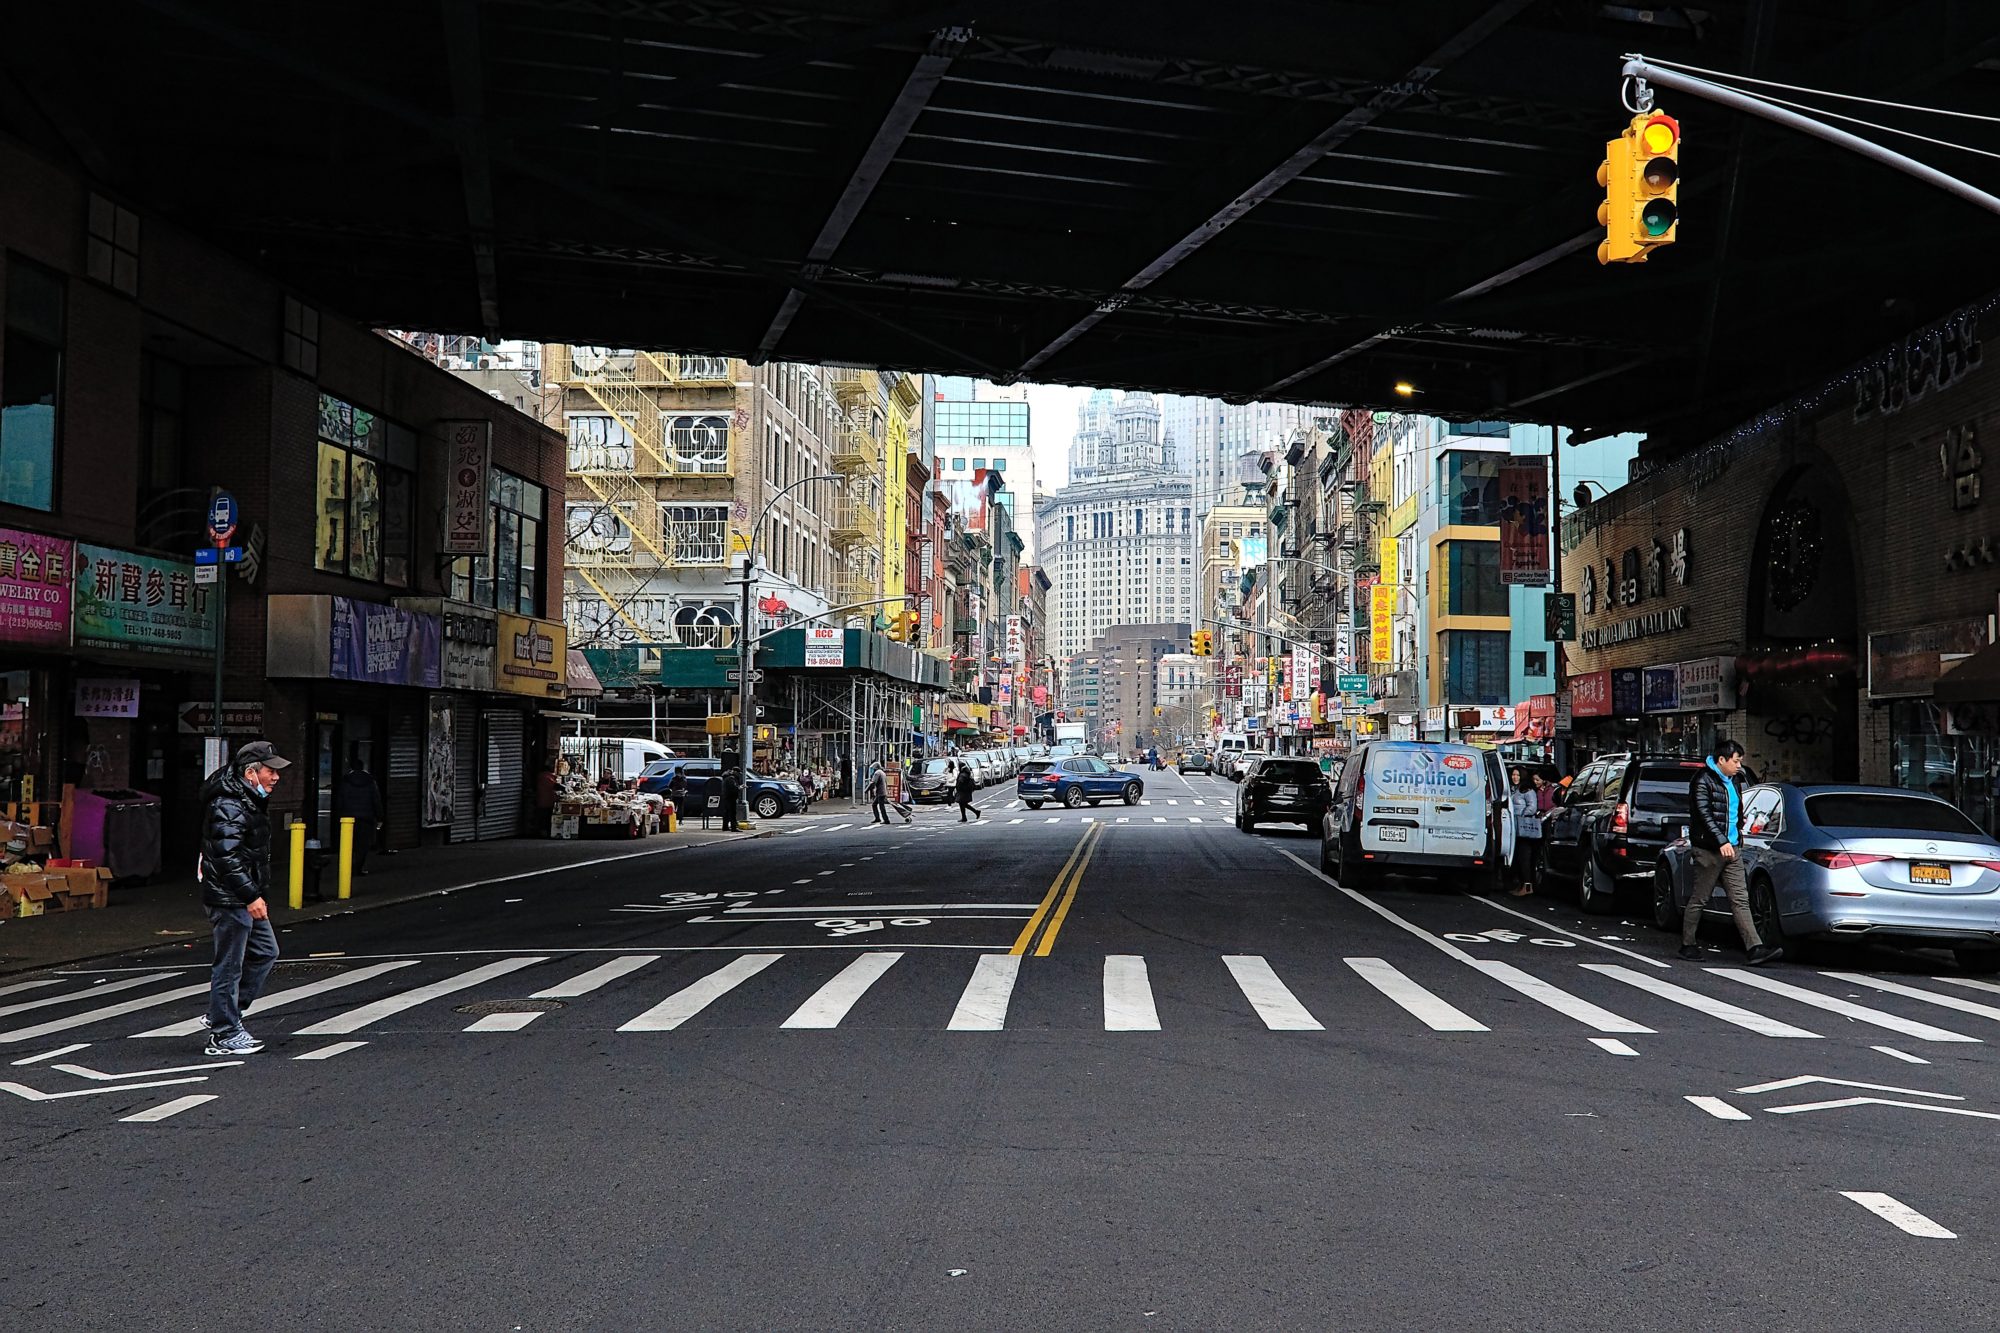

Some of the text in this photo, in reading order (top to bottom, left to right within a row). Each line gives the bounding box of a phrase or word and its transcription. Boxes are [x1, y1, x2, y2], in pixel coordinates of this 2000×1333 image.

[44, 589, 62, 603] CO.
[124, 625, 139, 636] TEL:
[1599, 618, 1637, 646] BROADWAY
[1641, 611, 1666, 636] MALL
[1668, 606, 1685, 631] INC
[815, 629, 833, 637] RCC
[1382, 769, 1467, 788] Simplified
[1398, 785, 1453, 796] Cleaner
